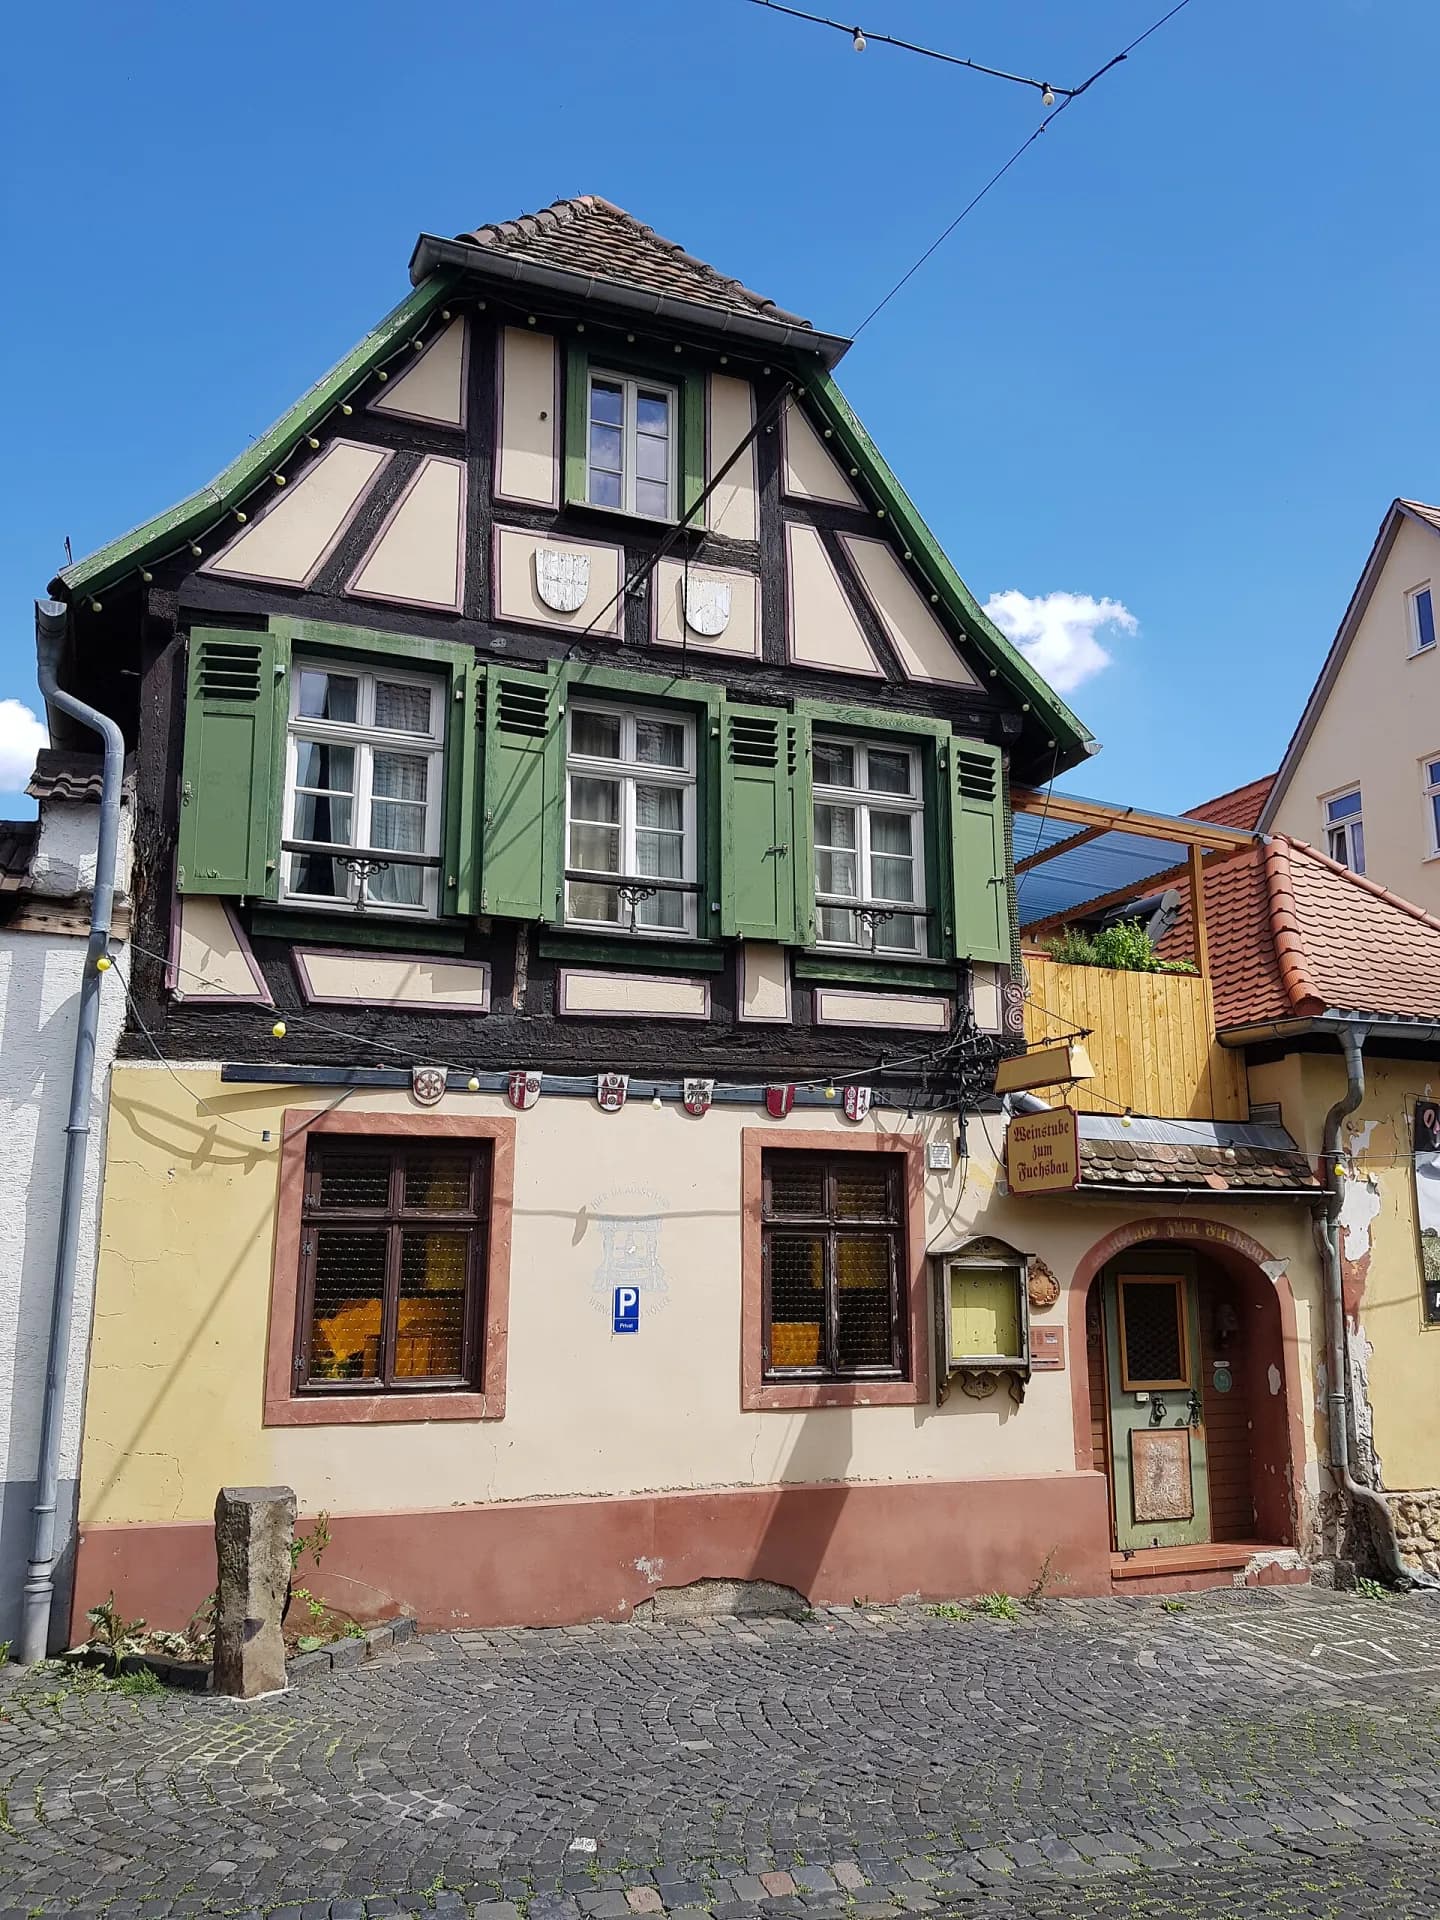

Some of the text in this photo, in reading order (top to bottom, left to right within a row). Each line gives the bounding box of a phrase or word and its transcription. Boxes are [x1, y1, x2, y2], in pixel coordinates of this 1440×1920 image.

[1013, 1119, 1070, 1142] Weinstube
[1032, 1143, 1053, 1158] zum
[1016, 1160, 1069, 1182] Fuchsbau
[619, 1288, 637, 1317] P
[1227, 1613, 1421, 1643] ANNO
[1309, 1634, 1440, 1664] 173
